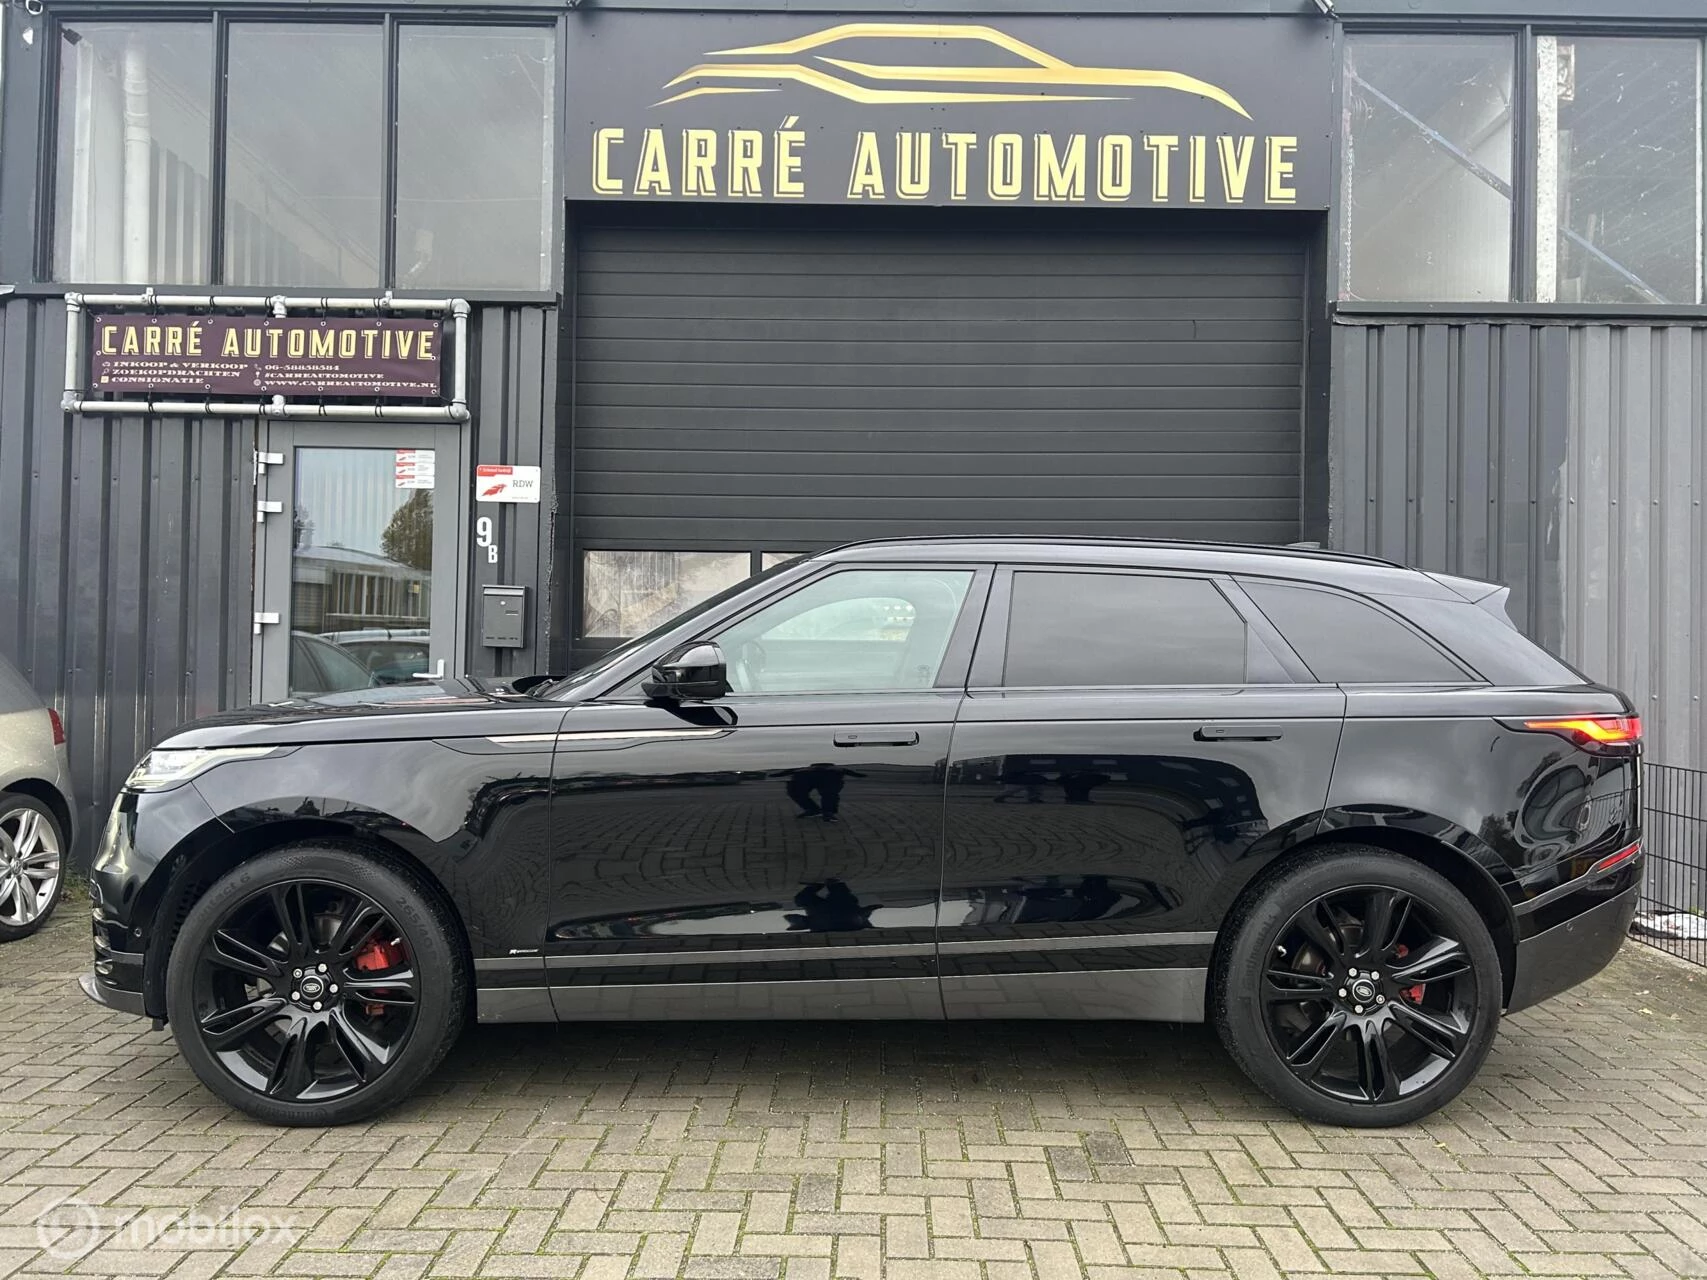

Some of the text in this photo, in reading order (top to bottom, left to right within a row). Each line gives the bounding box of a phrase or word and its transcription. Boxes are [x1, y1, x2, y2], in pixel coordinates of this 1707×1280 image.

[592, 115, 1298, 203] CARRÉ AUTOMOTIVE
[101, 320, 434, 360] CARRÉ AUTOMOTIVE
[112, 368, 241, 377] ZOEKOPDRACHTEN
[264, 380, 437, 388] WWW.CARREAUTOMOTIVE.NL
[512, 479, 534, 488] RDW
[476, 516, 498, 564] 9 B
